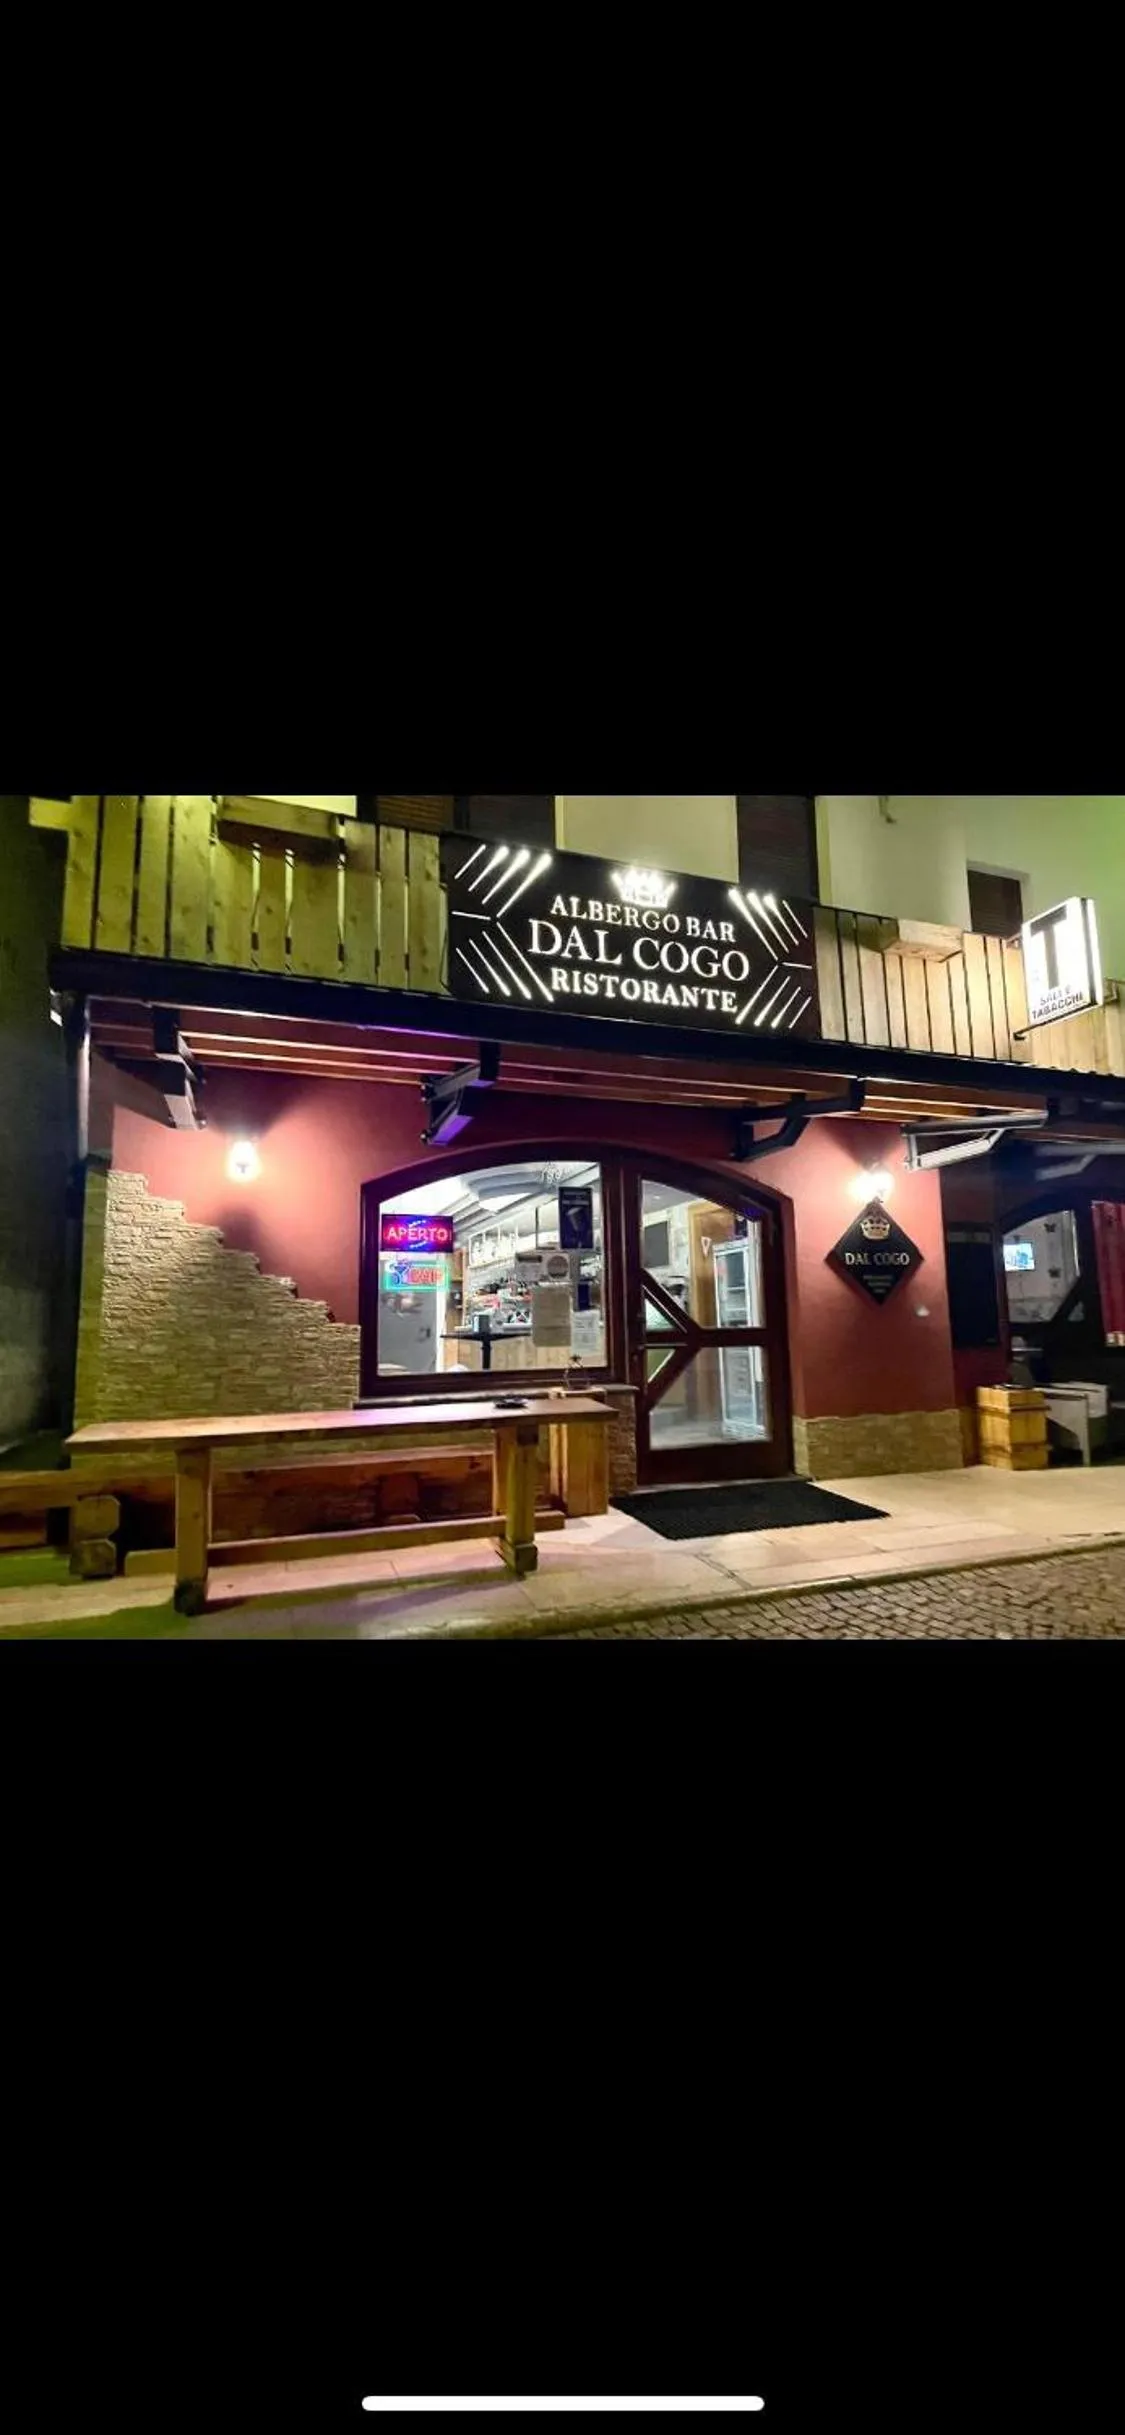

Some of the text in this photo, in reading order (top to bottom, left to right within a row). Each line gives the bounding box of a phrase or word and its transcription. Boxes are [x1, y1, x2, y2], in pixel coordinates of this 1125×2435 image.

[550, 895, 736, 943] ALBERGO BAR
[528, 918, 750, 982] DAL COGO
[550, 967, 738, 1013] RISTORANTE
[1032, 991, 1083, 1020] TABACCHI
[387, 1227, 449, 1242] APERTO
[844, 1252, 910, 1266] DAL COGO
